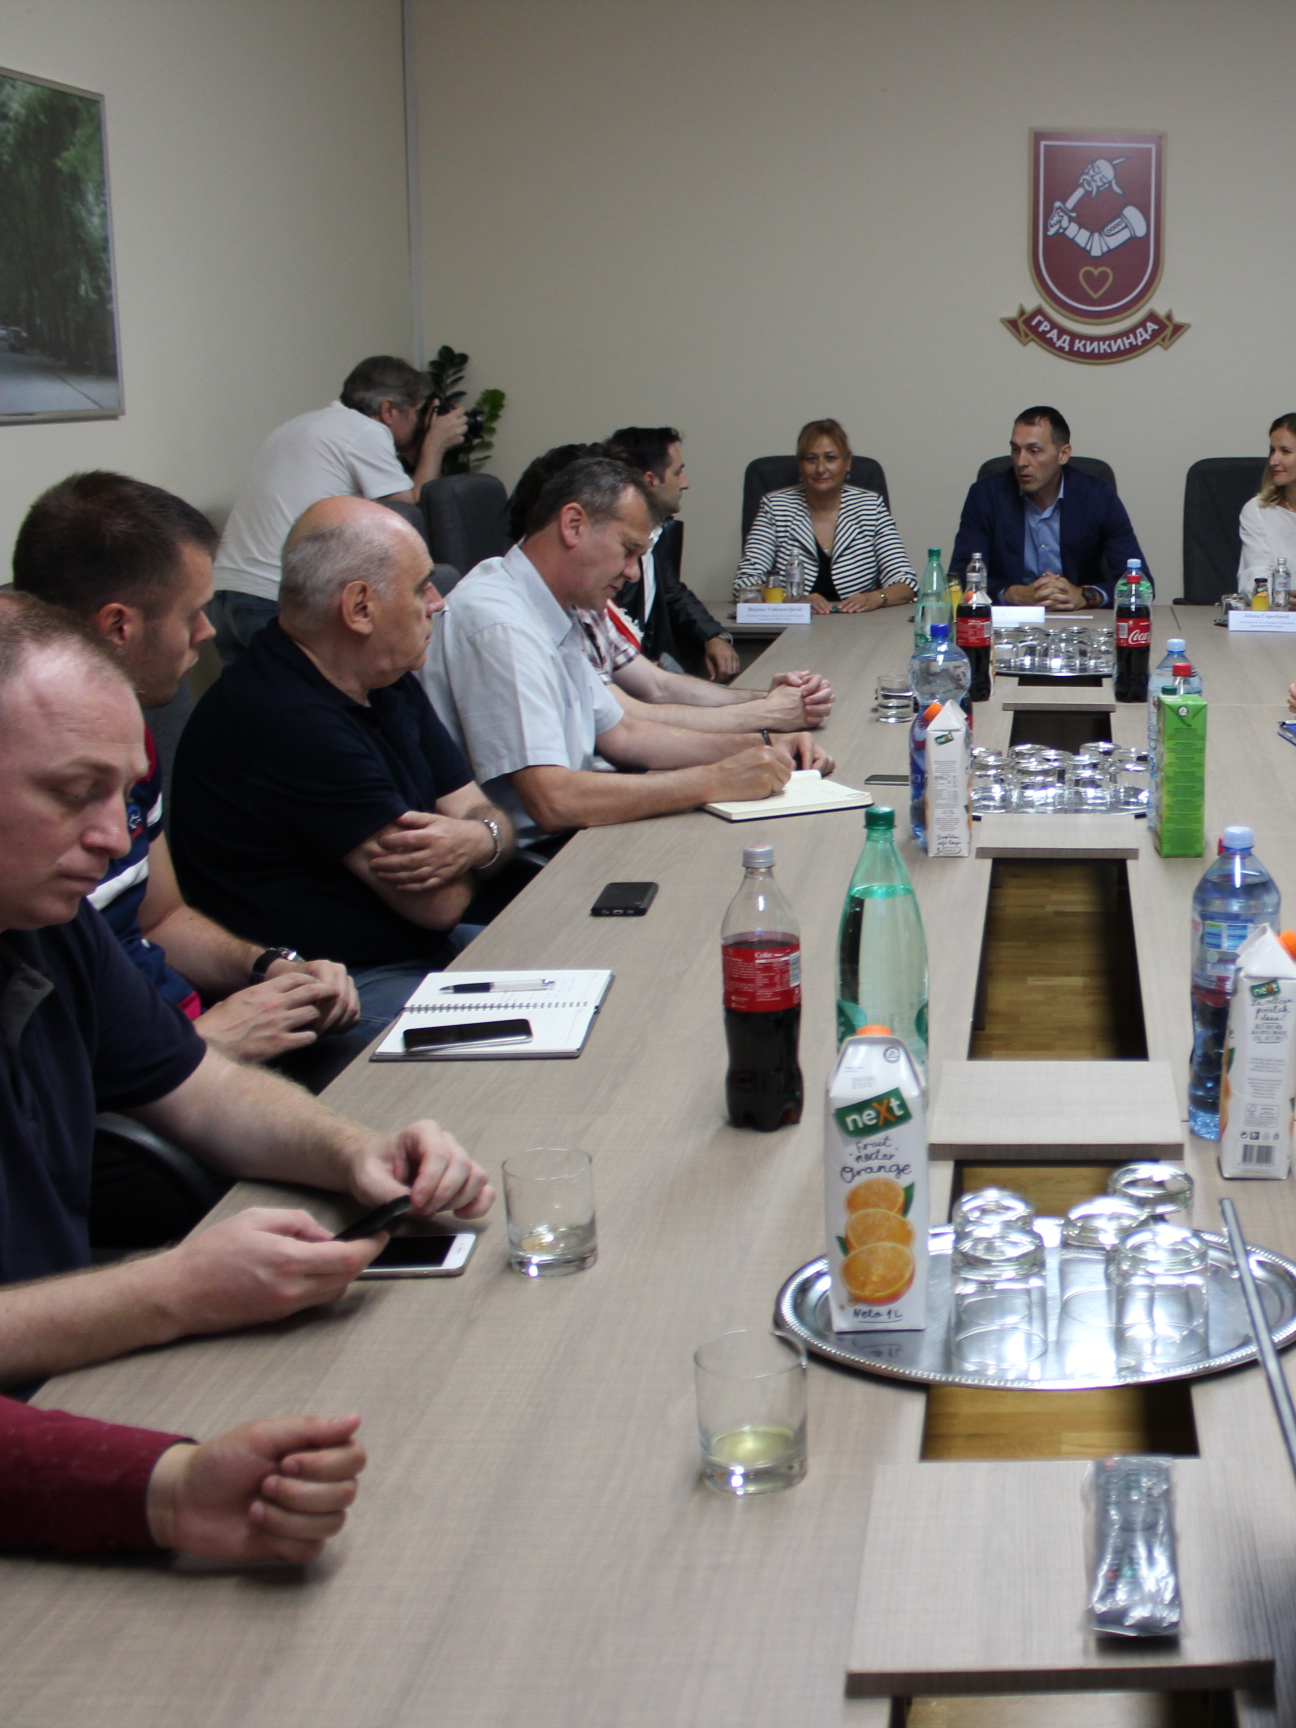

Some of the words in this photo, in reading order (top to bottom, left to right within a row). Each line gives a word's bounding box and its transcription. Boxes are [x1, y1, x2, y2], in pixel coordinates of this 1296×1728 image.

[1030, 314, 1070, 352] ГРАД
[1073, 320, 1160, 354] КИКИНДА
[855, 1135, 893, 1154] Fruit
[840, 1163, 912, 1184] Orange
[852, 1307, 883, 1320] Neto
